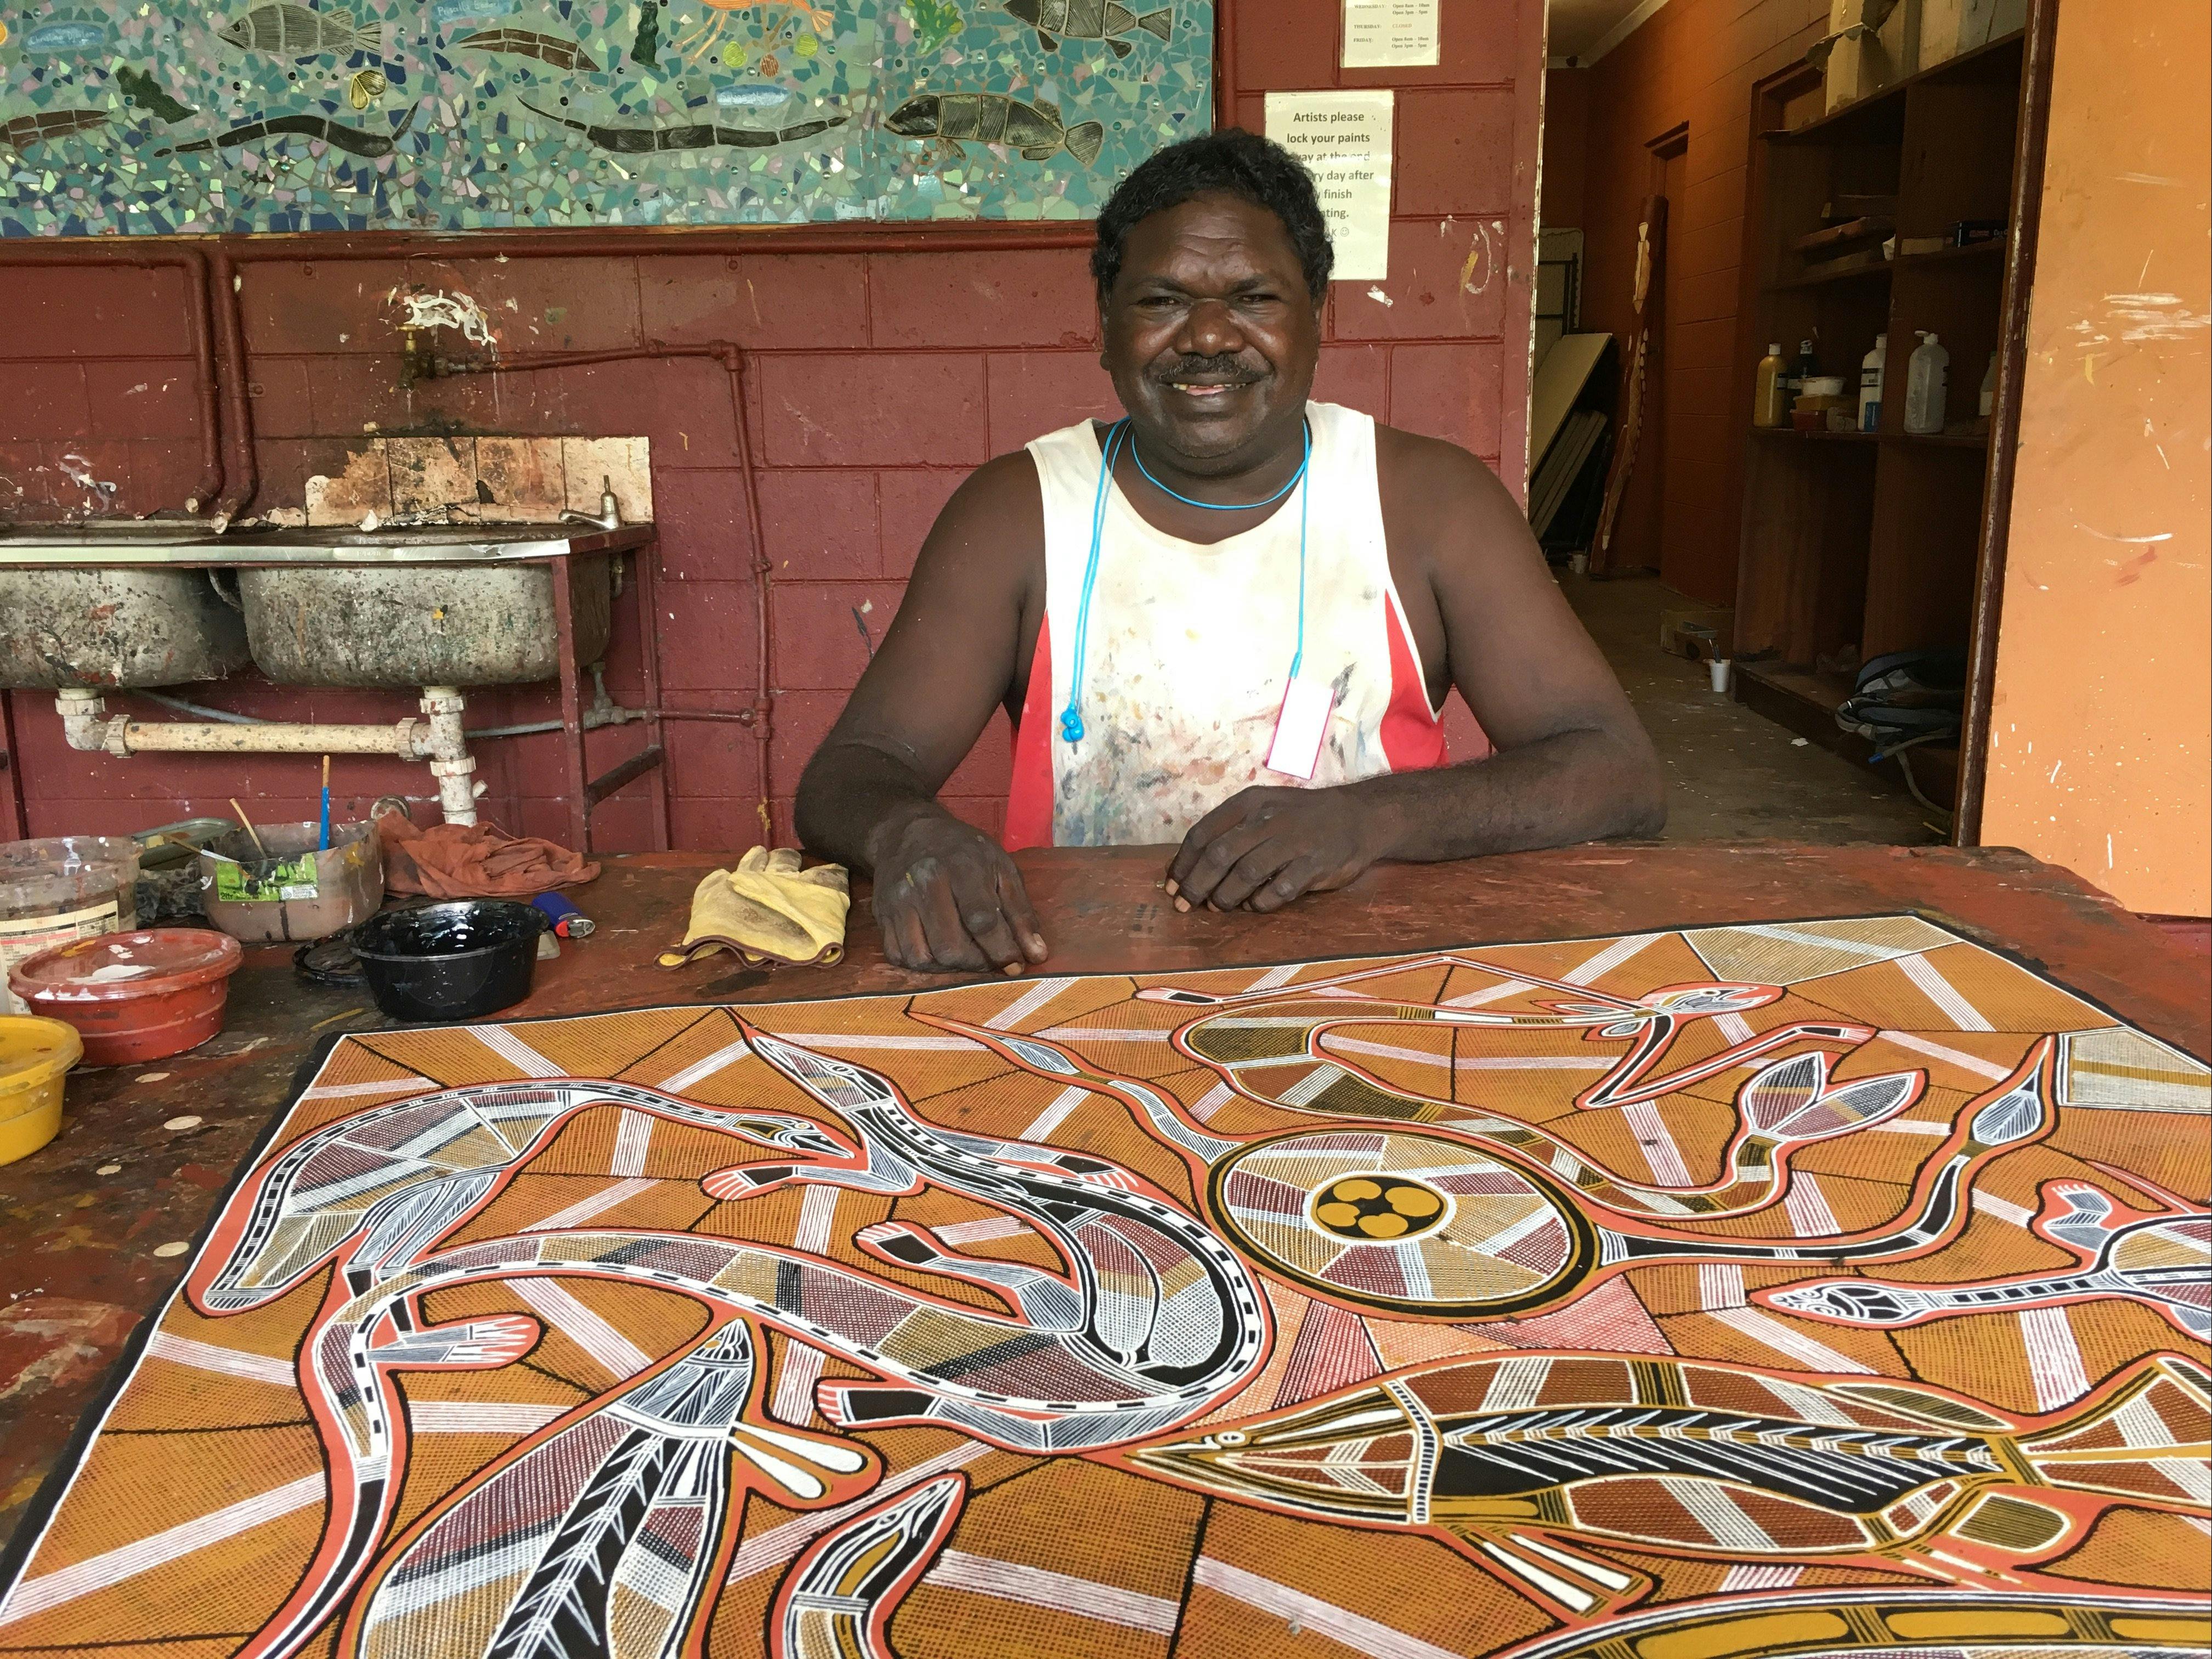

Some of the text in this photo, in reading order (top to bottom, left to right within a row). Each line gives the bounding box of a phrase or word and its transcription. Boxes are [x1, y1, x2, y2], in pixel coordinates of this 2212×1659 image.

[1293, 111, 1365, 124] Artists please
[1287, 132, 1371, 145] lock your paints
[1316, 153, 1327, 161] at
[1326, 170, 1346, 182] day
[1348, 170, 1374, 180] after
[1323, 188, 1352, 199] finish
[1320, 207, 1349, 219] nting.
